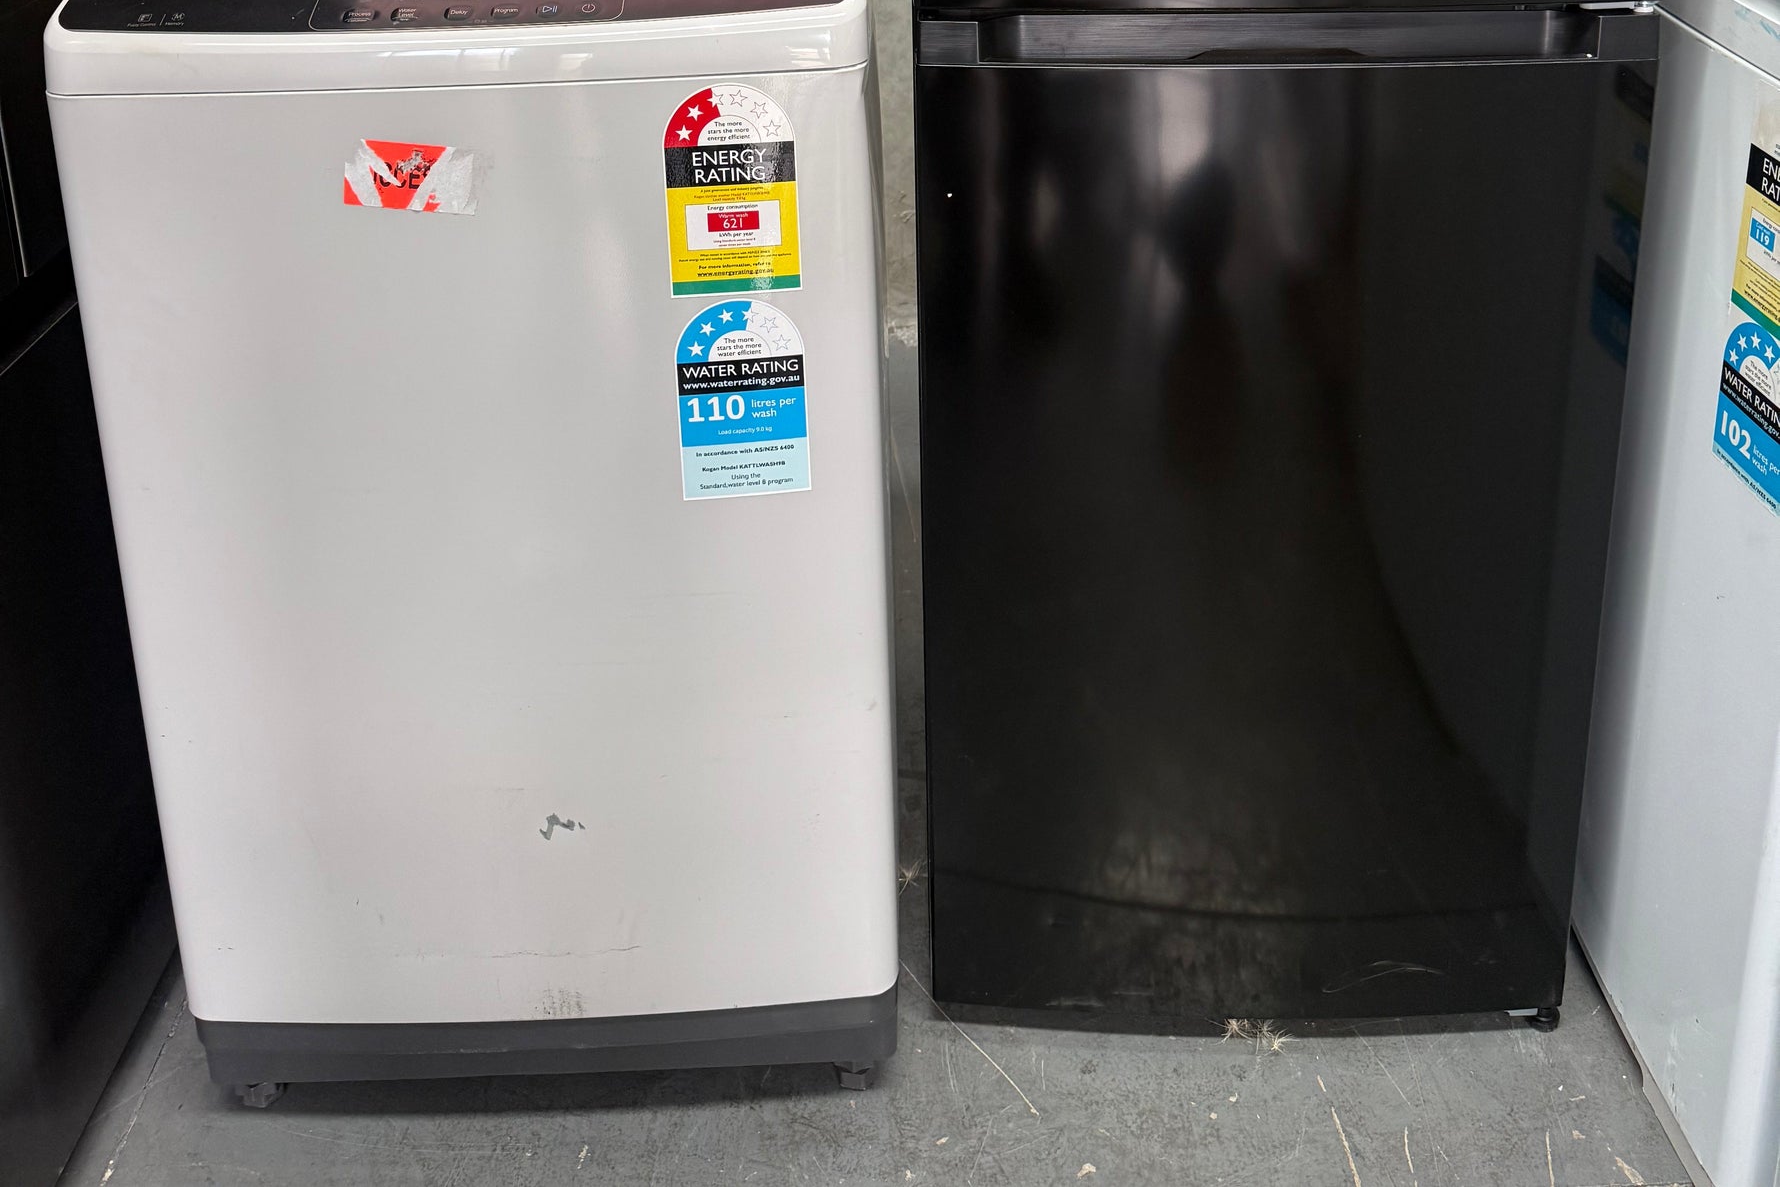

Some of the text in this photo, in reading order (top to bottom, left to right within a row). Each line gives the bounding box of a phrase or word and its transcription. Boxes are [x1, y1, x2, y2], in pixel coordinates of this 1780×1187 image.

[692, 148, 767, 167] ENERGY
[695, 166, 766, 184] RATING
[722, 218, 743, 229] 621
[1755, 229, 1770, 246] 119
[682, 359, 799, 379] WATER RATING
[683, 374, 800, 390] www.waterrating.gov.au
[1724, 366, 1752, 404] WATER
[686, 394, 796, 423] 110 litres per
[752, 408, 777, 419] wash
[733, 427, 756, 436] capacity
[1720, 410, 1752, 460] 102
[1752, 444, 1768, 466] litres
[703, 448, 738, 456] accordance
[1752, 456, 1768, 476] wash
[731, 474, 749, 482] Using
[768, 476, 794, 486] program
